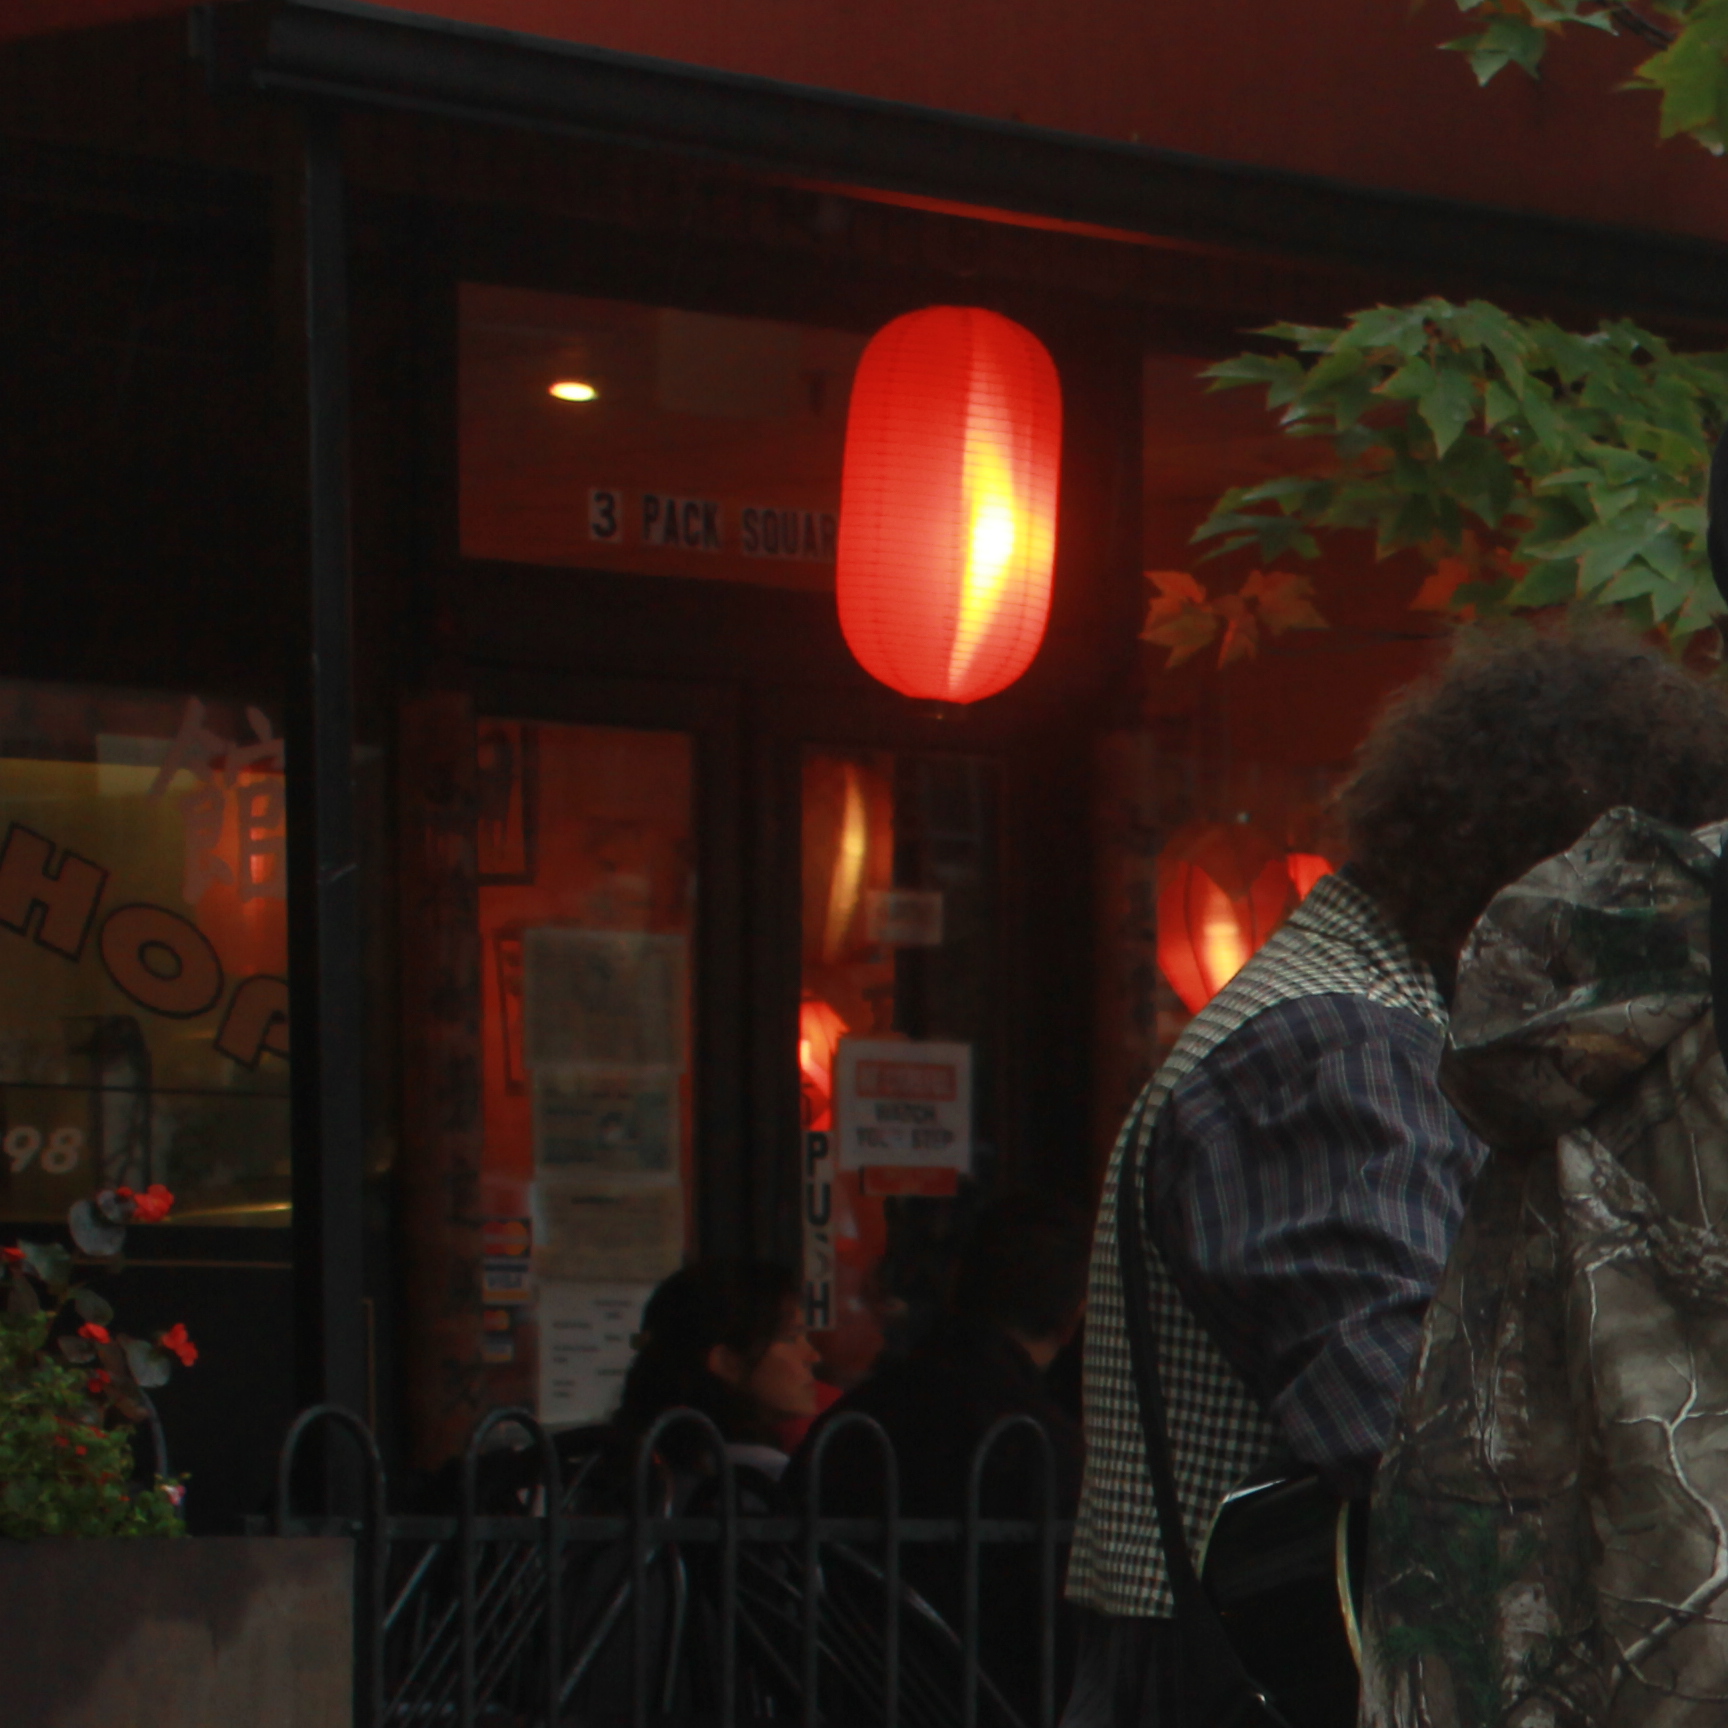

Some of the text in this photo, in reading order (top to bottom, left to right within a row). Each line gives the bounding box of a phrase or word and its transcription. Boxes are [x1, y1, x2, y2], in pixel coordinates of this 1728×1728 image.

[592, 491, 837, 559] 3 PACK SQUAR
